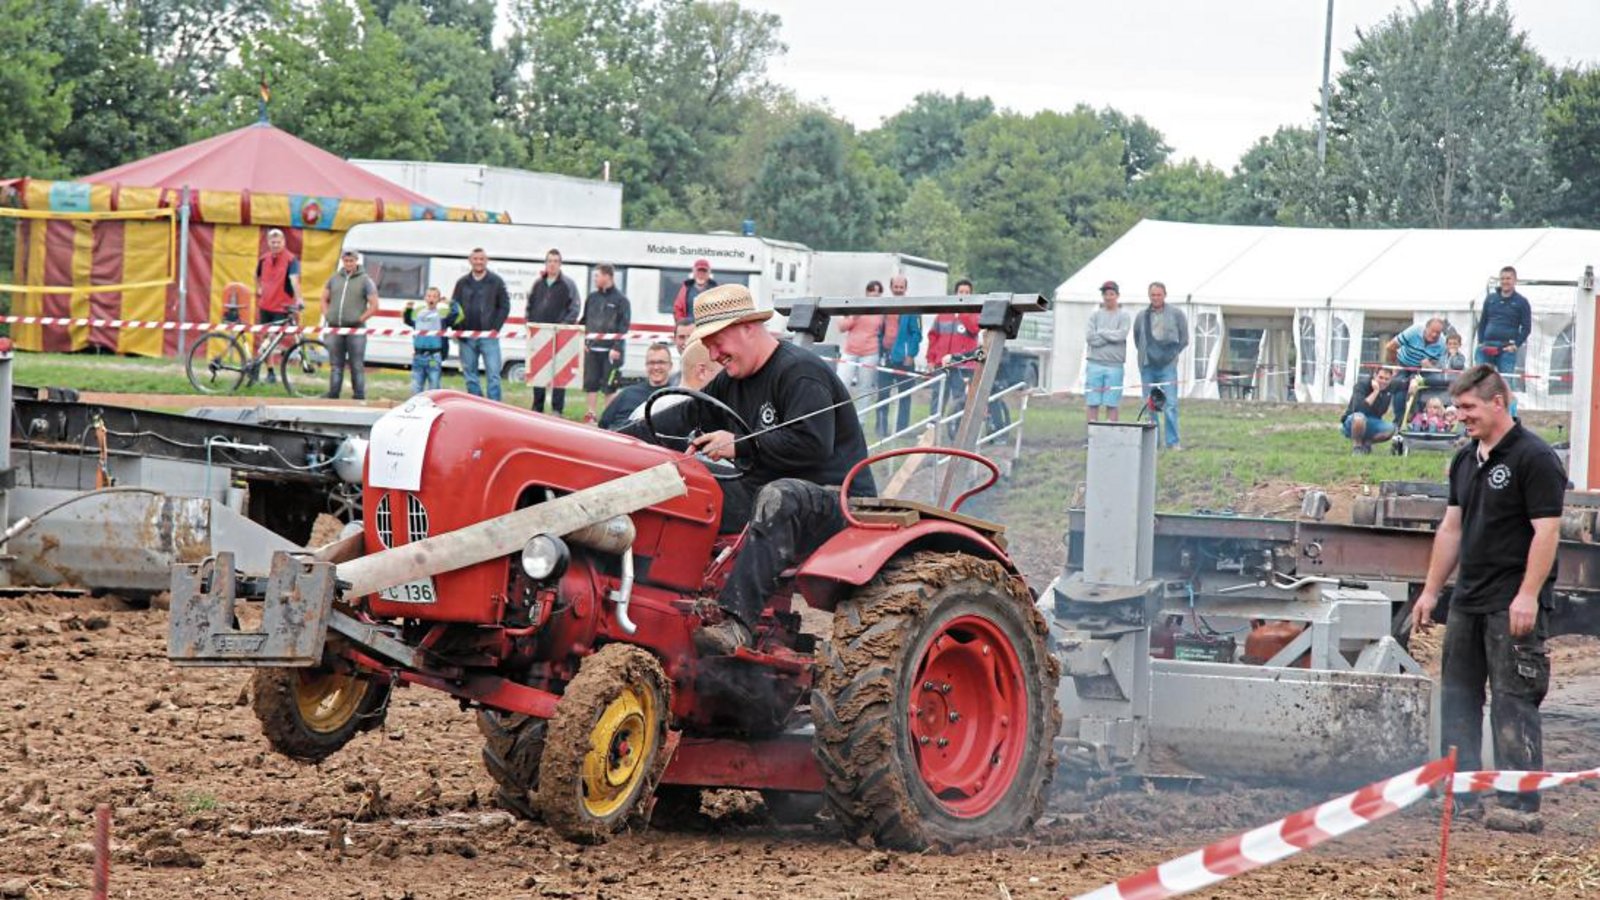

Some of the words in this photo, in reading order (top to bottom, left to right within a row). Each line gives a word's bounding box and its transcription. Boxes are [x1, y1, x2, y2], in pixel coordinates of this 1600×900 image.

[647, 244, 677, 254] Mobile
[679, 246, 745, 258] Sanitätswache
[404, 584, 432, 600] 136
